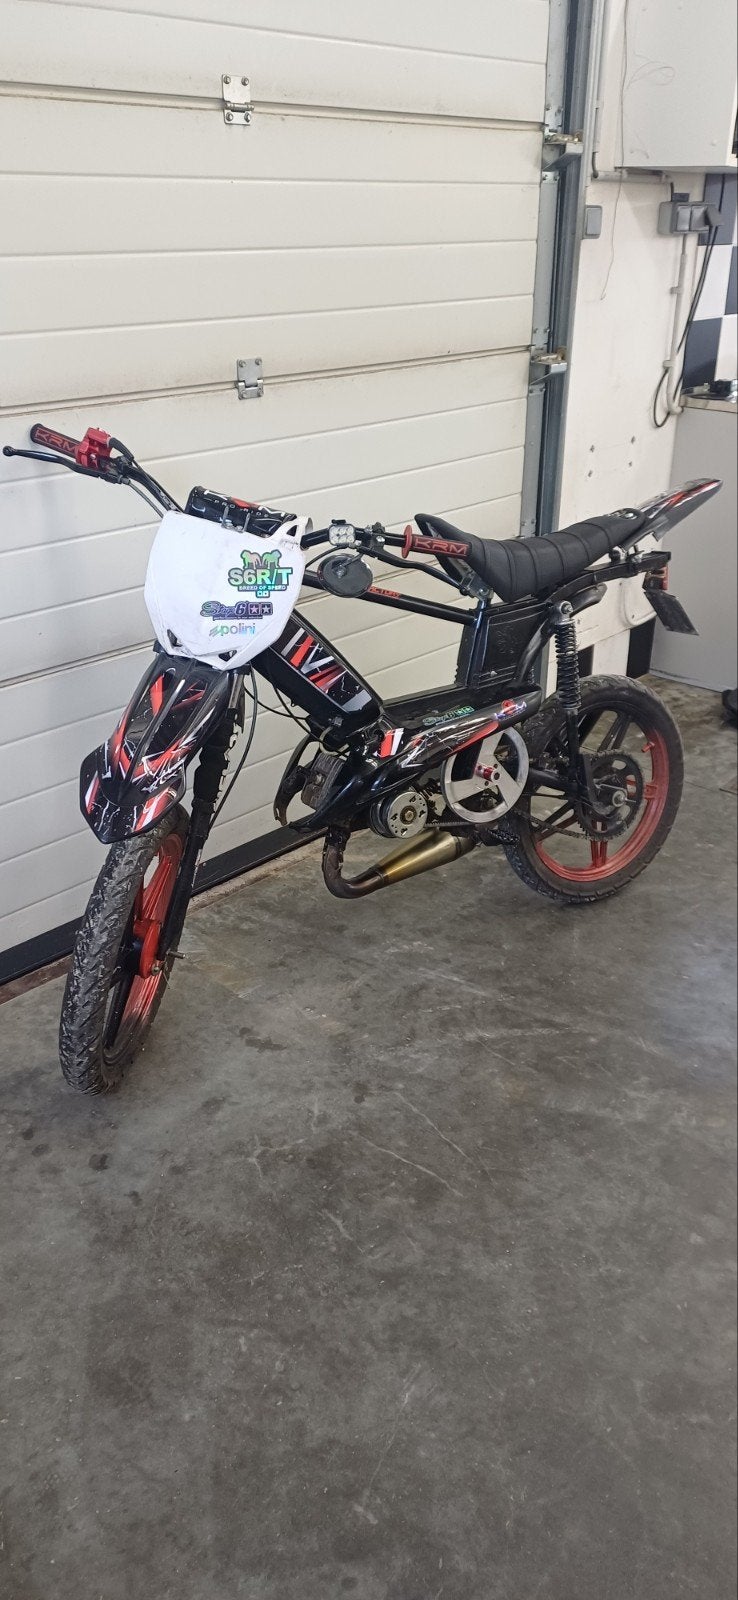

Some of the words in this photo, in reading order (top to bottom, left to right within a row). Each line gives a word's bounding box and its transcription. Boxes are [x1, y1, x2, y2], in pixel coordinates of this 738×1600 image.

[414, 537, 468, 556] KRM
[228, 567, 293, 586] S6R/T
[220, 622, 256, 636] polini
